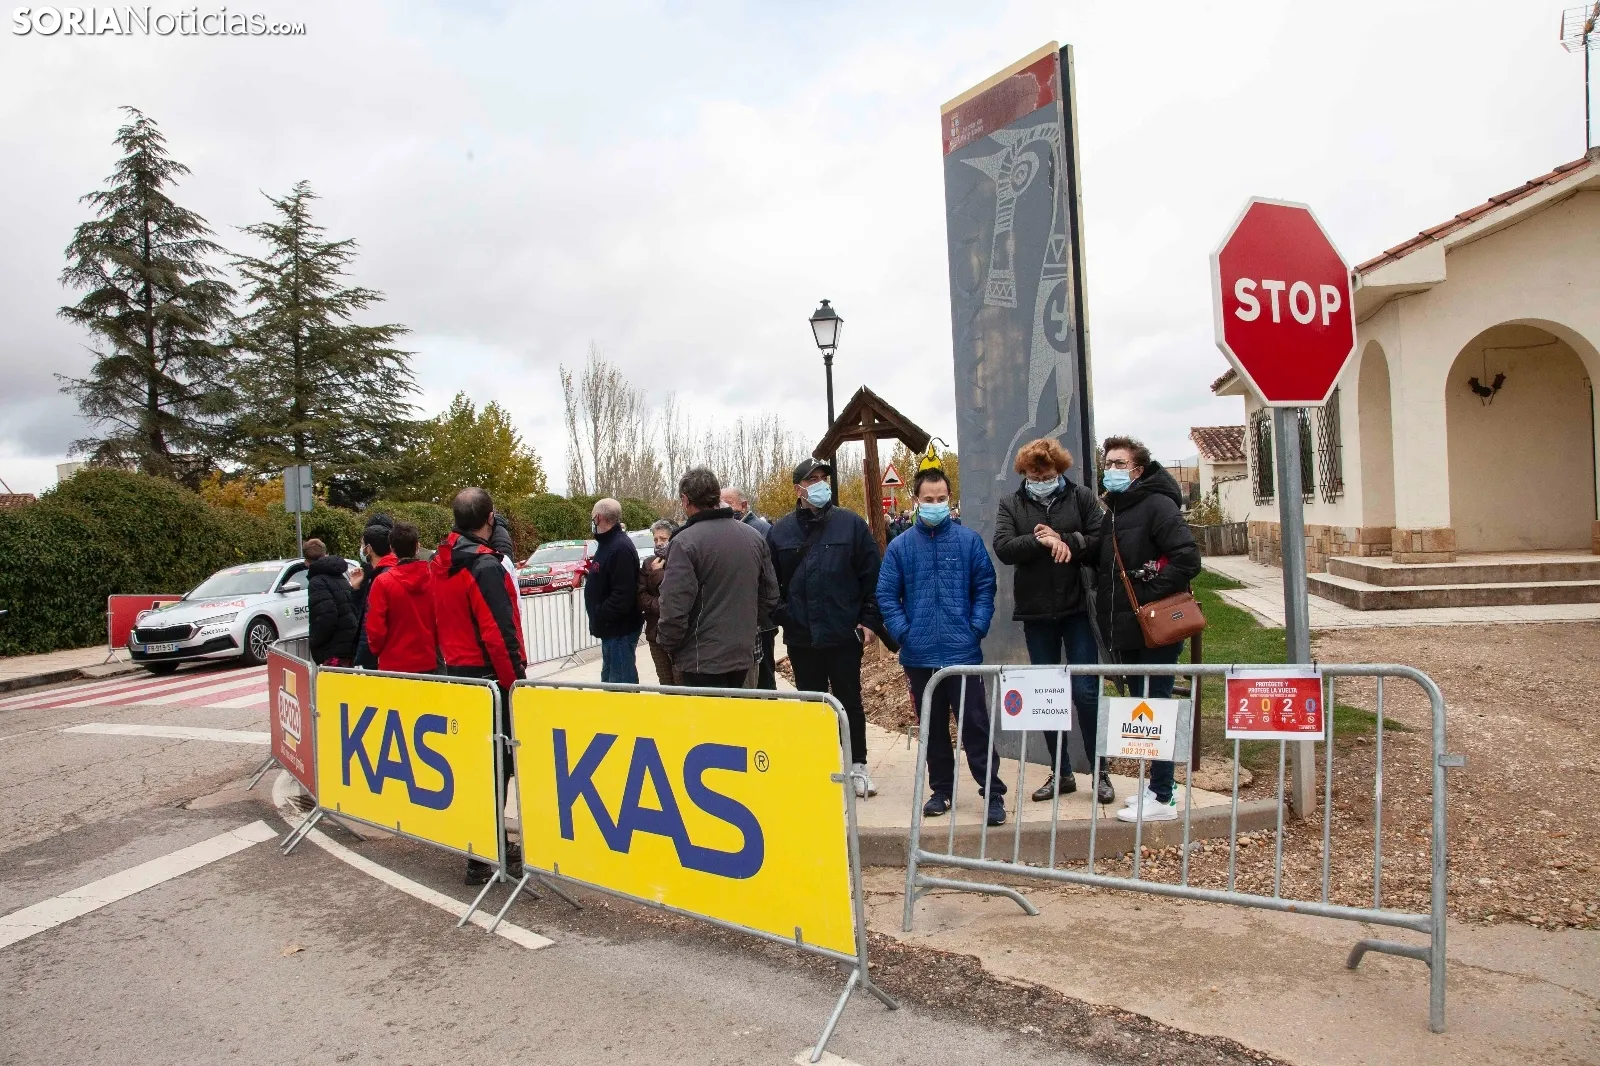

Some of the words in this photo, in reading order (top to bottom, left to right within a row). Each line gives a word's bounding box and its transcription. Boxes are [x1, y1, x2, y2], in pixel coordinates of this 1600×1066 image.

[1234, 277, 1342, 326] STOP
[1239, 698, 1249, 712] 2
[1261, 698, 1271, 712] 0
[1283, 698, 1293, 712] 2
[1305, 698, 1316, 713] 0
[1121, 722, 1162, 736] Mavyal
[340, 702, 455, 810] KAS
[1121, 747, 1133, 755] 902
[1147, 749, 1159, 757] 902
[552, 727, 765, 880] KAS
